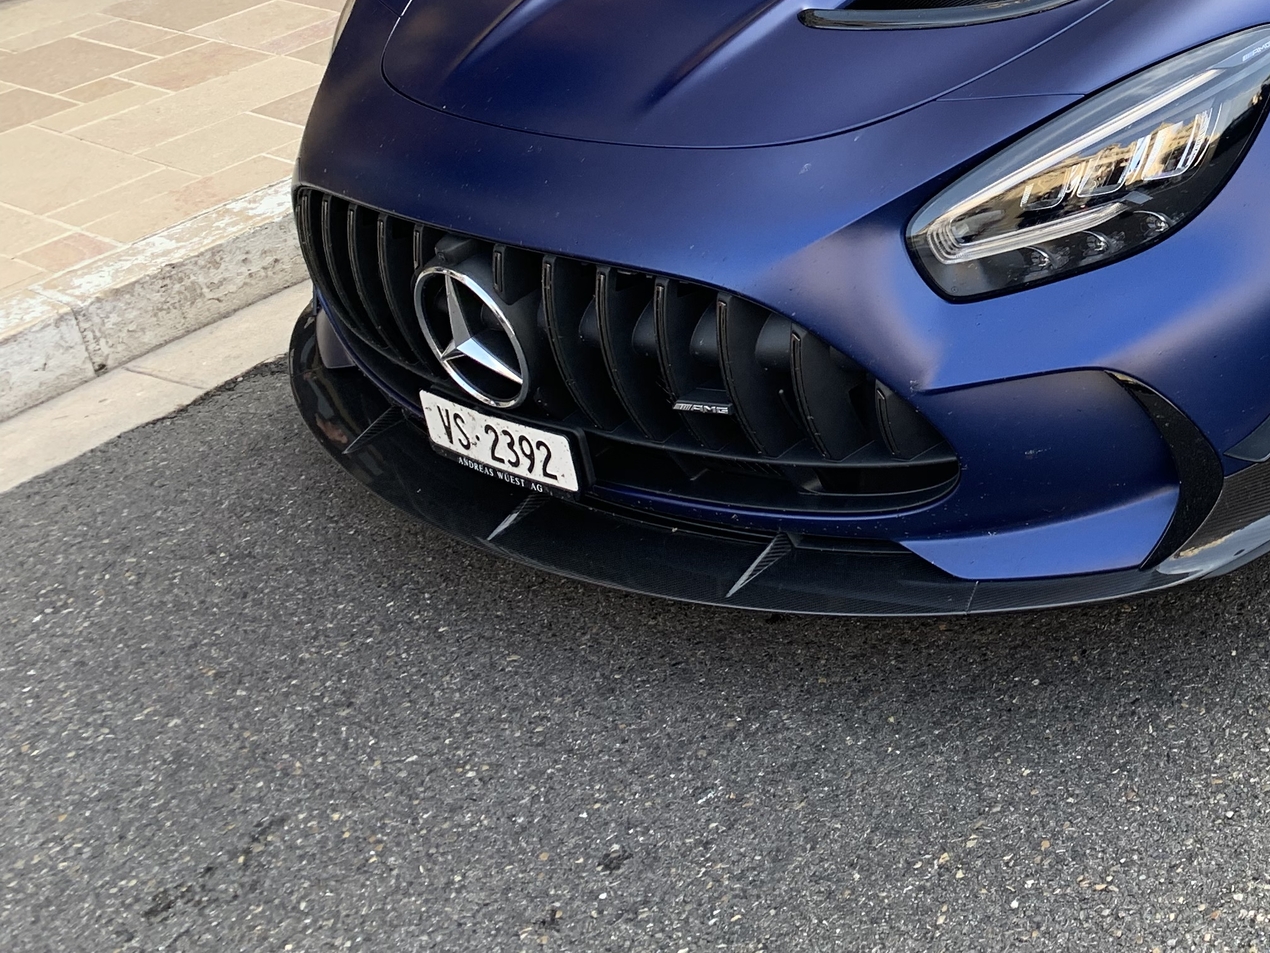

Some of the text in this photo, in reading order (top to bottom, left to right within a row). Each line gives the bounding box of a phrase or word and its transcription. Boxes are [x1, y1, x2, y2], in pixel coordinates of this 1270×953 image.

[691, 404, 728, 415] AMG
[458, 456, 495, 478] ANDREAS
[530, 482, 543, 493] AG
